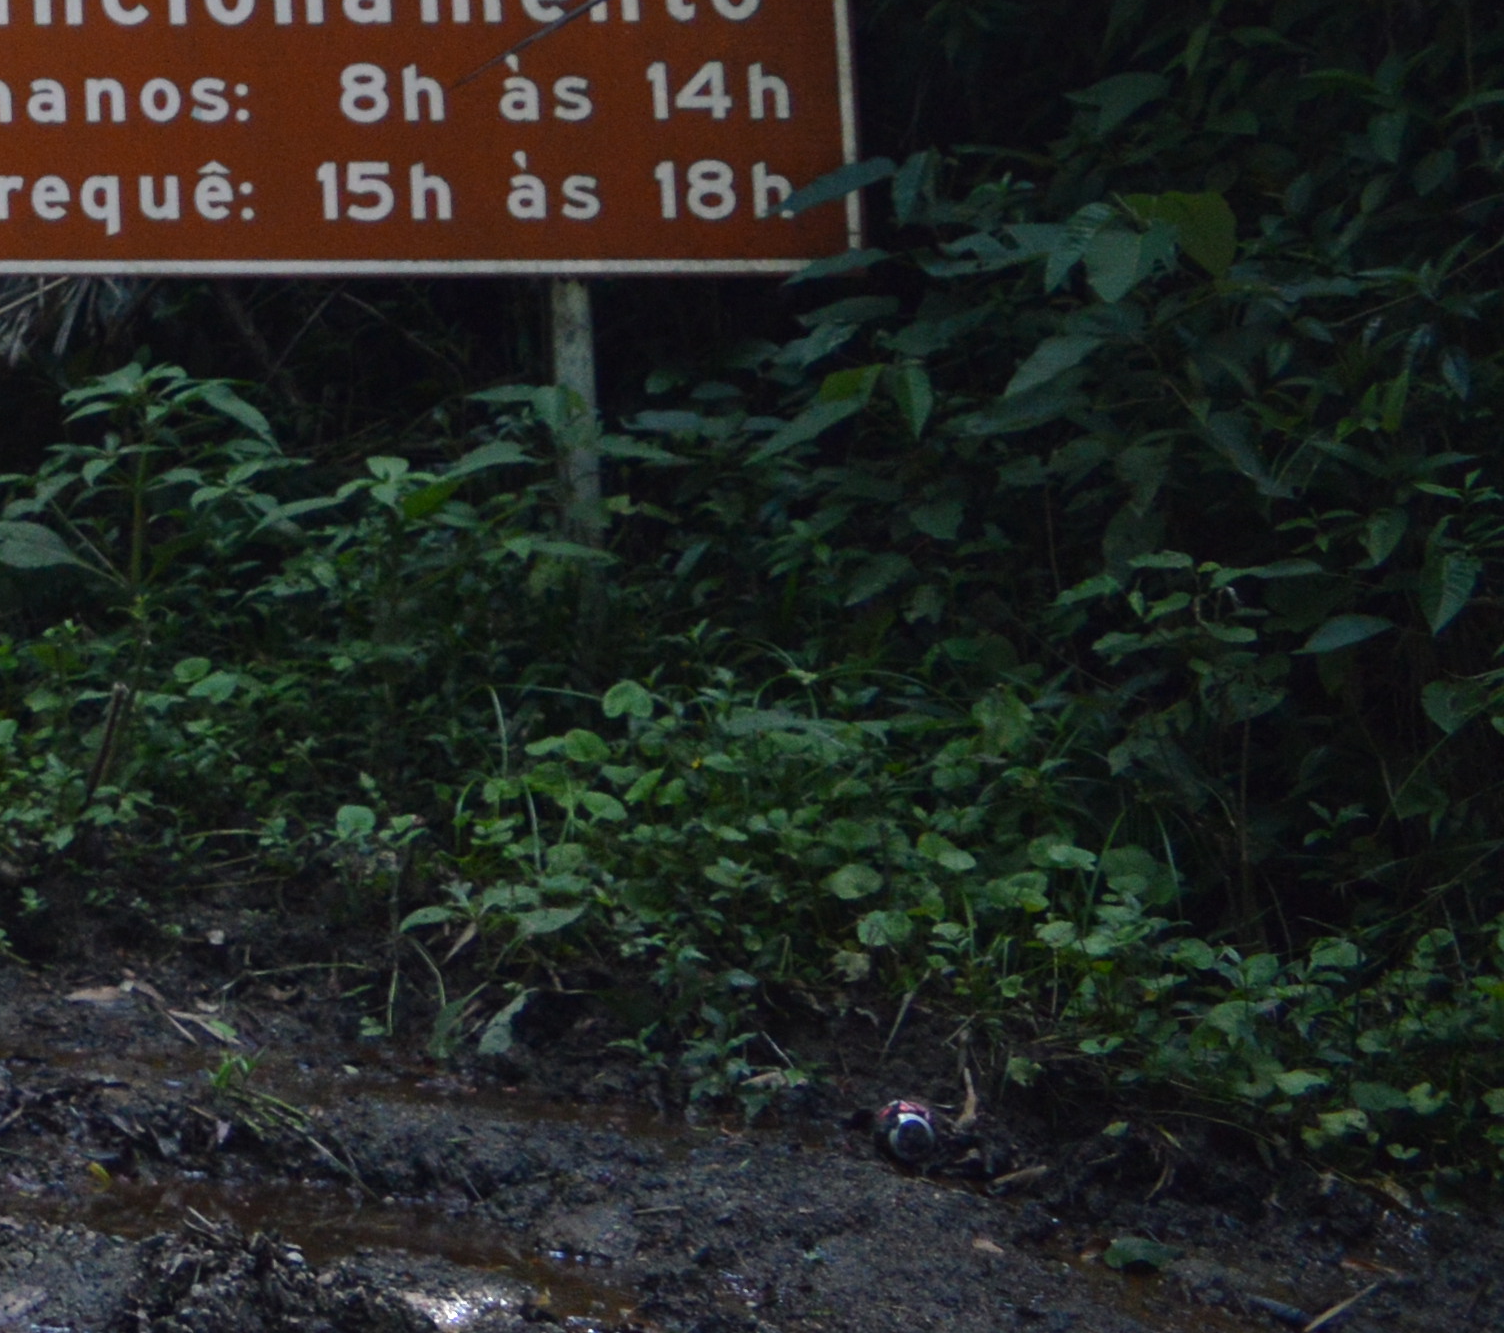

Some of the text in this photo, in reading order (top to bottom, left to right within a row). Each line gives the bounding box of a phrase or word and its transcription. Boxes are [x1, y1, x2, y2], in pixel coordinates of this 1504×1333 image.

[340, 63, 445, 123] 8h
[499, 53, 593, 121] às
[646, 61, 790, 120] 14h
[316, 161, 452, 222] 15h
[506, 150, 600, 220] às
[654, 159, 794, 220] 18h
